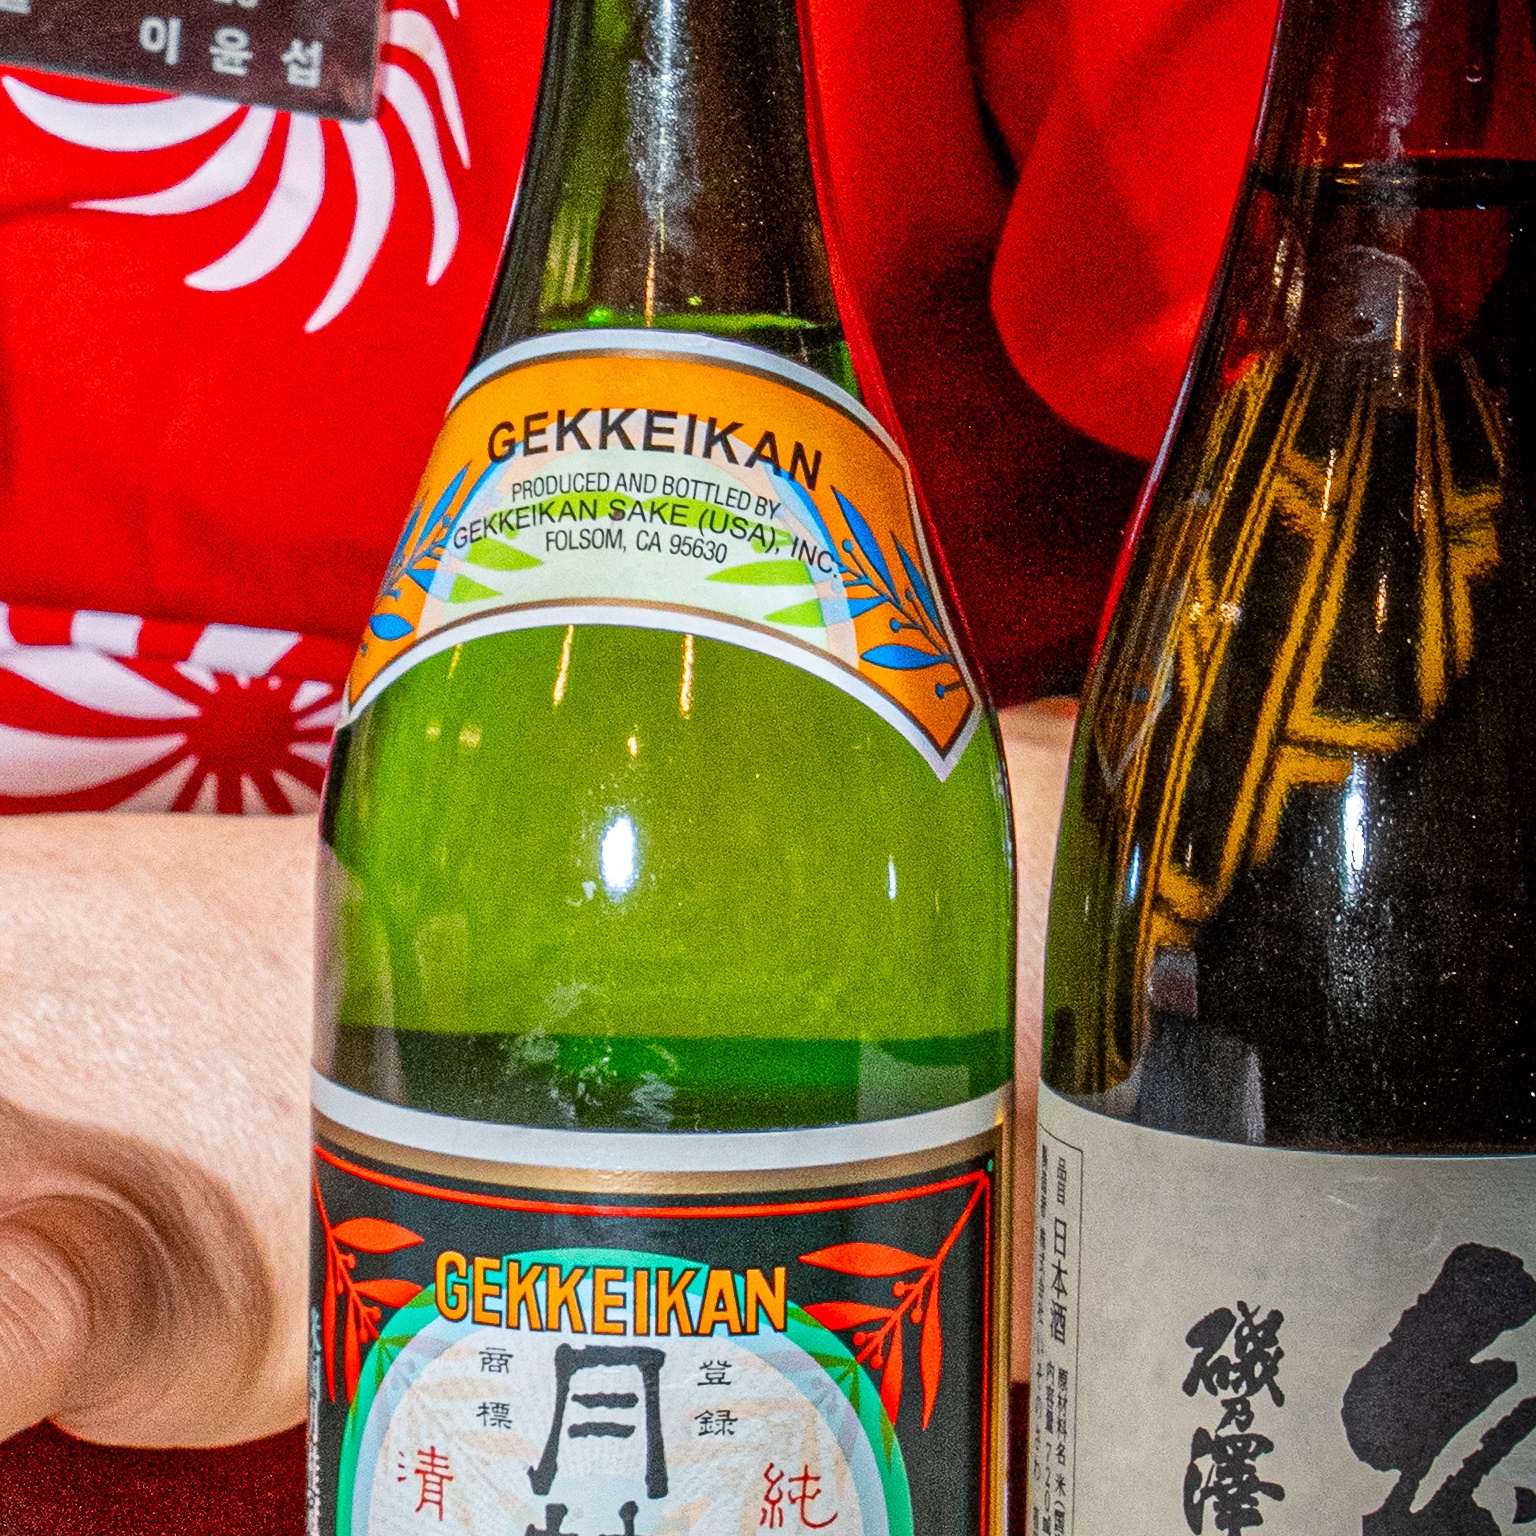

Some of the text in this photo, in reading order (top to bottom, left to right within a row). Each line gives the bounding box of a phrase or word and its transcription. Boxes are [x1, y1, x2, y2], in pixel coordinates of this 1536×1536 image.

[139, 15, 183, 65] 이
[487, 407, 823, 492] GEKKEIKAN
[511, 472, 782, 521] PRODUCED AND BOTTLED BY
[453, 498, 839, 579] GEKKEIKAN SAKE (USA), INC.
[545, 528, 728, 564] FOLSOM, CA 95630
[435, 1248, 789, 1337] GEKKEIKAN
[1050, 1216, 1068, 1345] 日本酒
[475, 1346, 514, 1430] 商標
